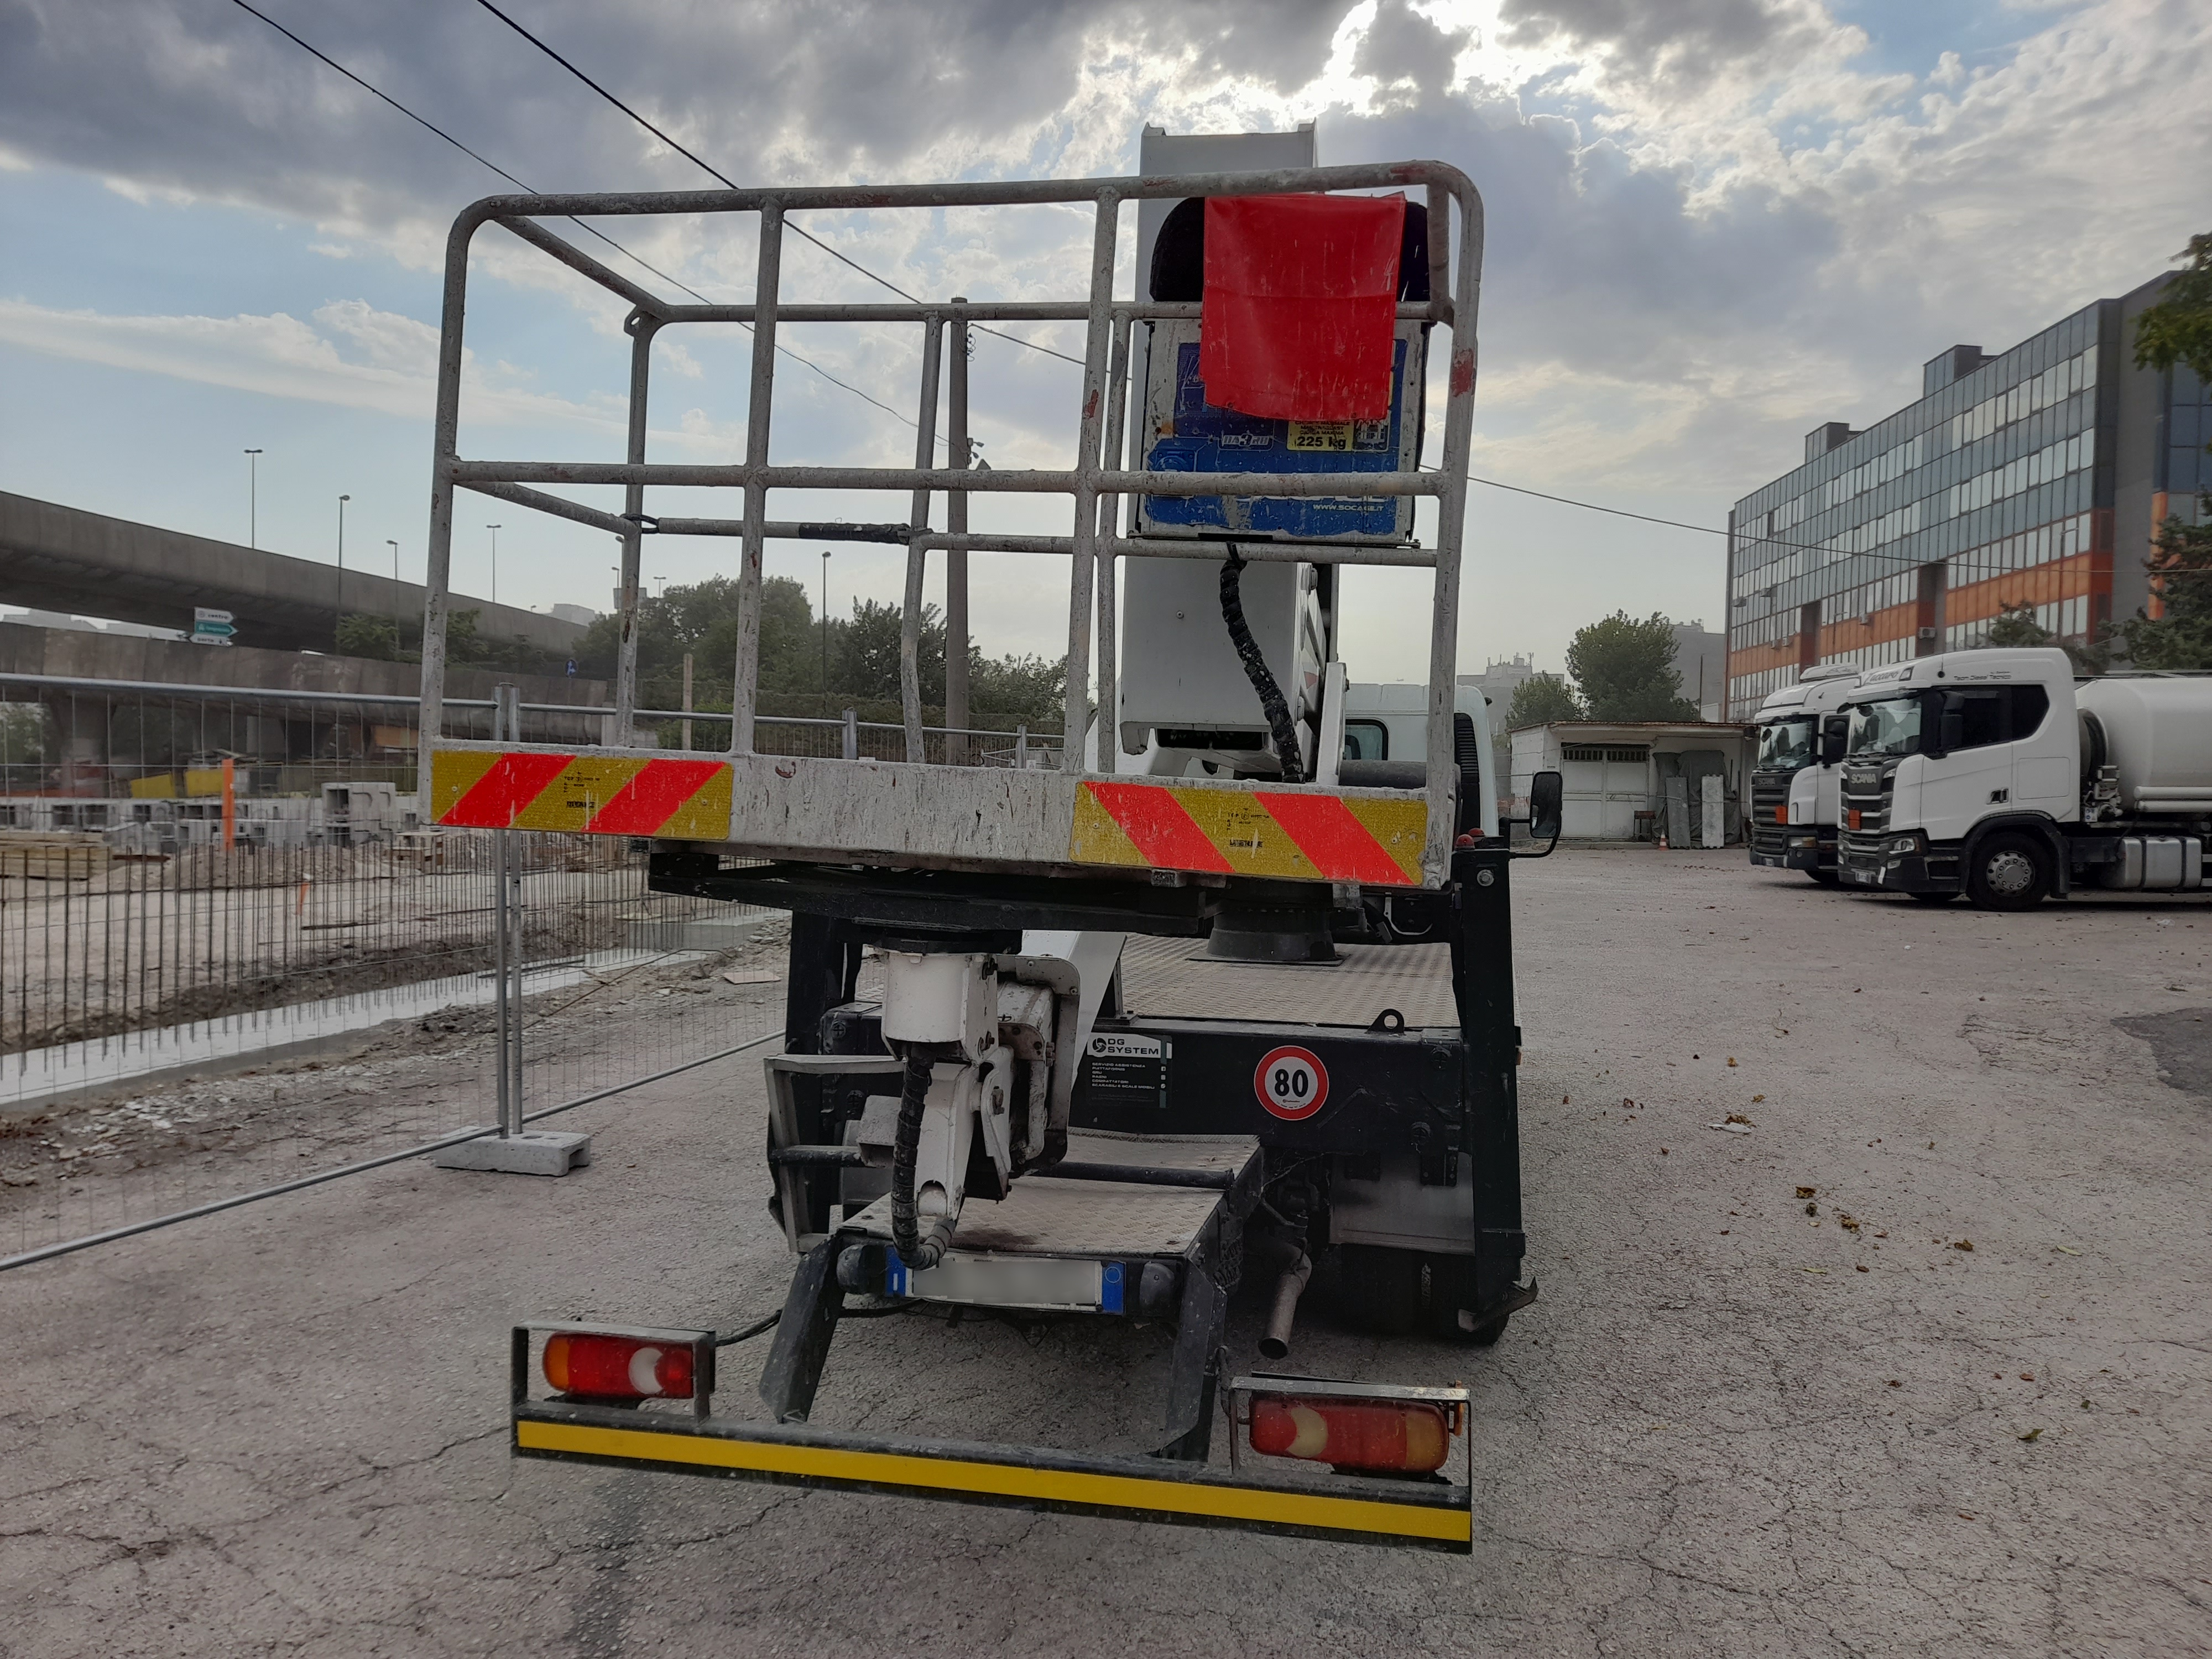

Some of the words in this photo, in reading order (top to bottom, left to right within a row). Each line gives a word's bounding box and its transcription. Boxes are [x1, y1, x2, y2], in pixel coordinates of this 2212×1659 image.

[1297, 436, 1323, 447] 225
[1328, 436, 1347, 450] kg
[1851, 773, 1876, 784] SCANIA
[1108, 1046, 1159, 1055] SYSTEM
[1275, 1068, 1308, 1097] 80
